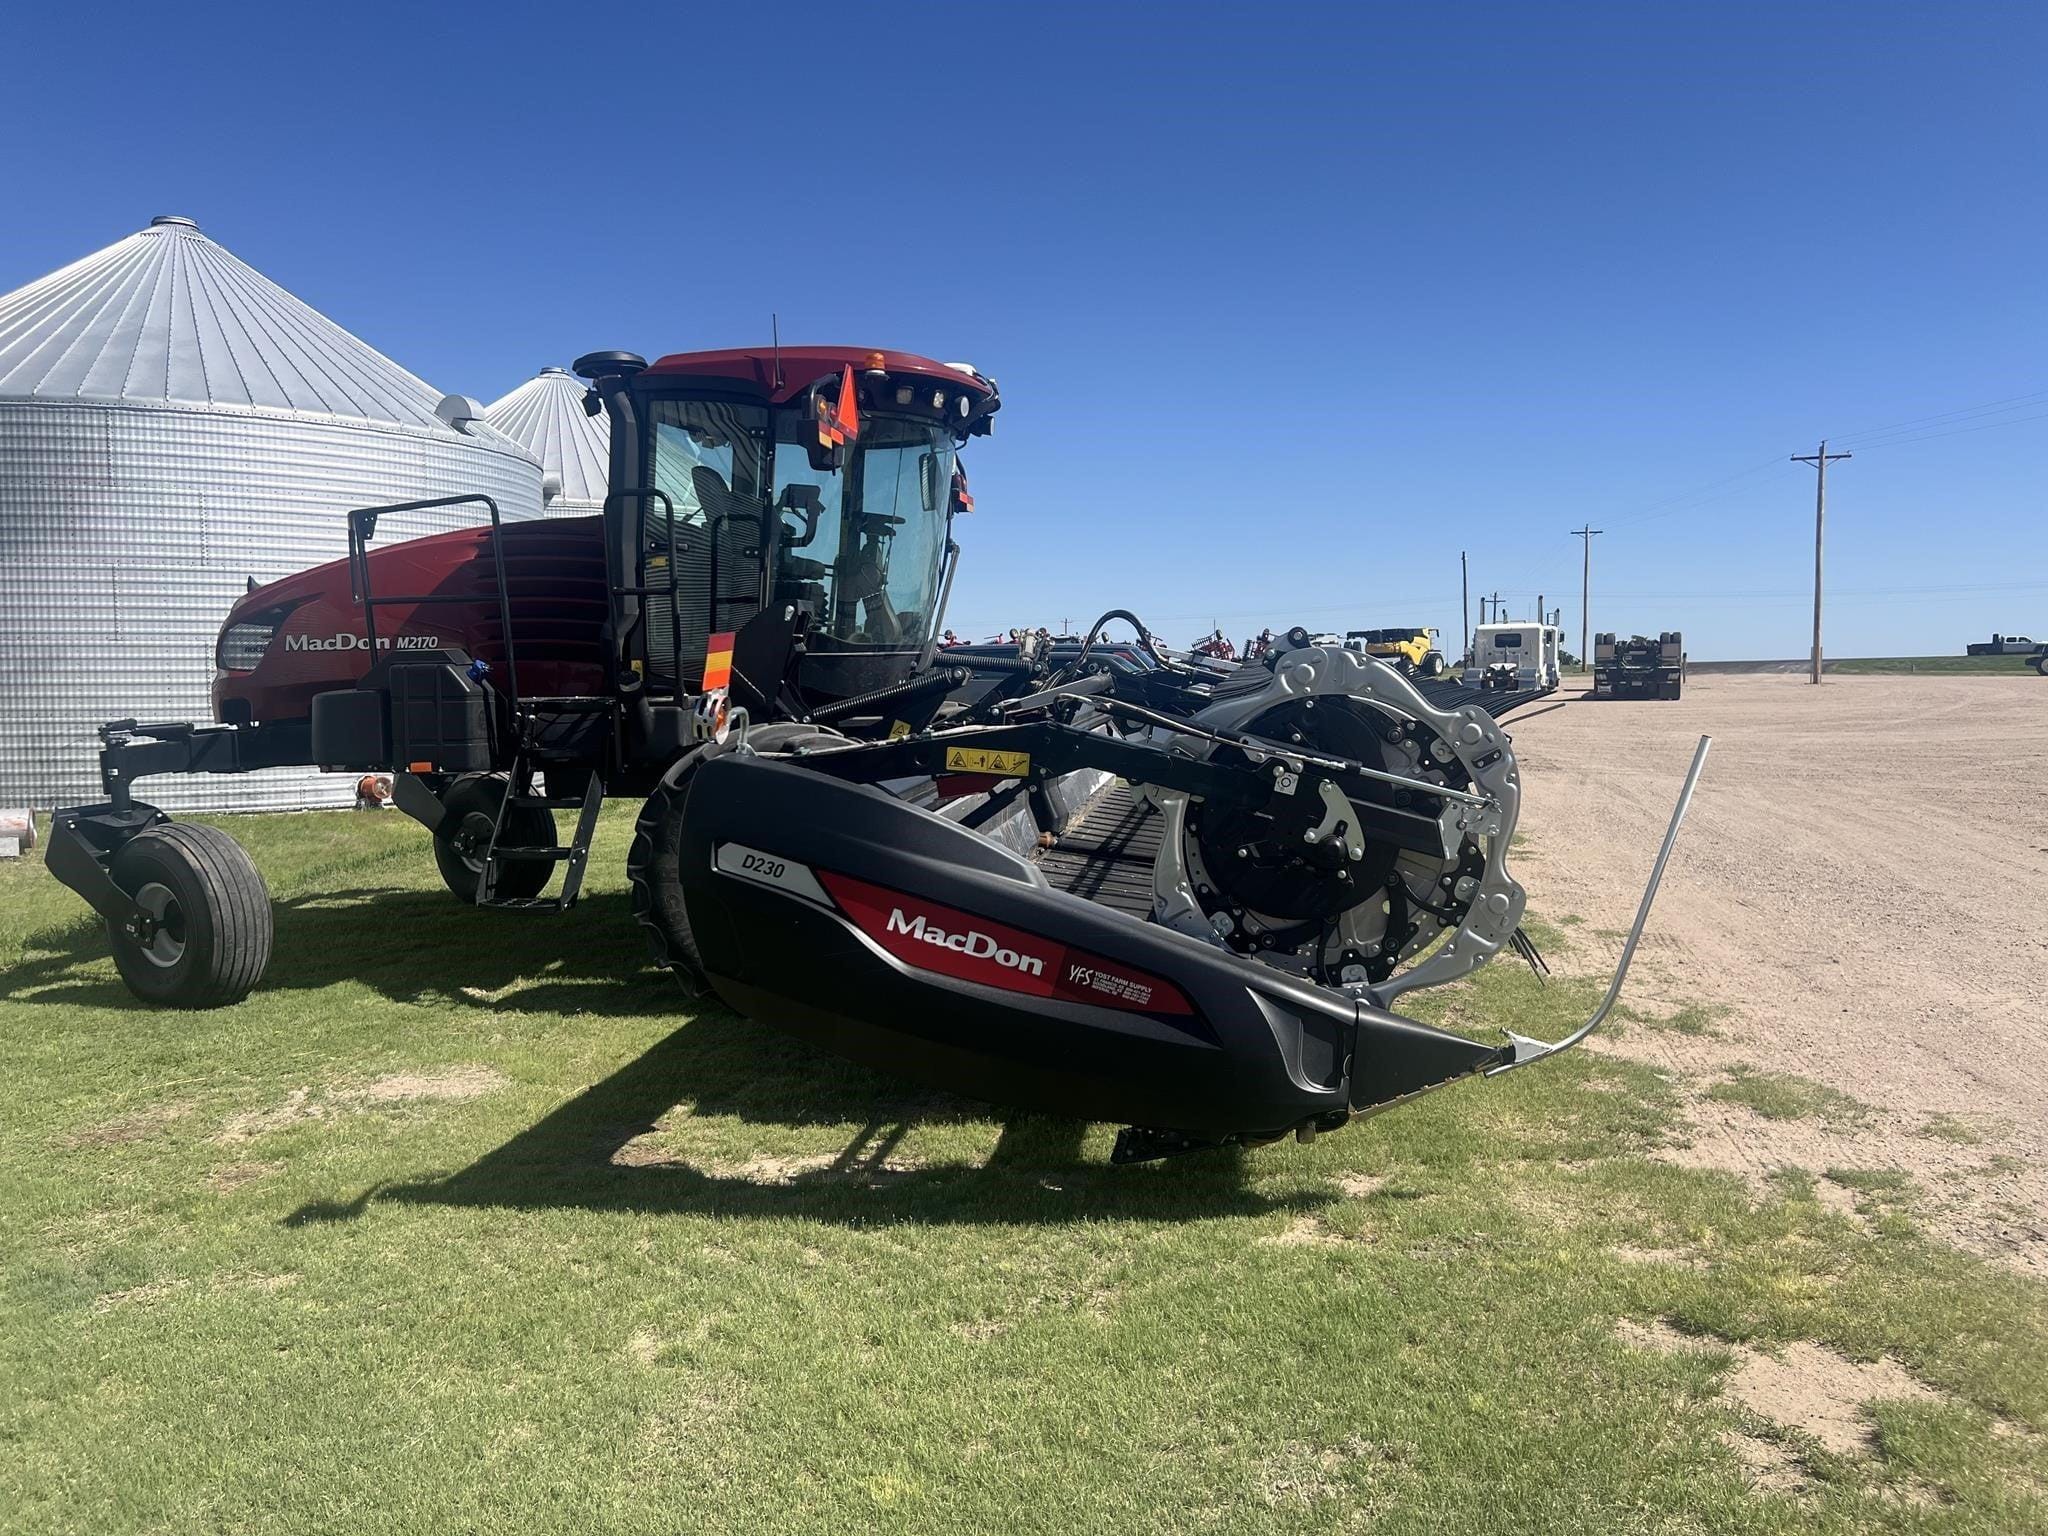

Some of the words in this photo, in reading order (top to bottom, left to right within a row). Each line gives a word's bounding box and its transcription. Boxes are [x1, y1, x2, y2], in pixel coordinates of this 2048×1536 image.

[285, 633, 390, 651] MacDon
[396, 636, 439, 649] M2170
[742, 854, 785, 878] D230
[886, 908, 1044, 976] MacDon
[1069, 964, 1094, 985] YFS
[1111, 976, 1129, 986] FARM
[1129, 981, 1153, 993] SUPPLY
